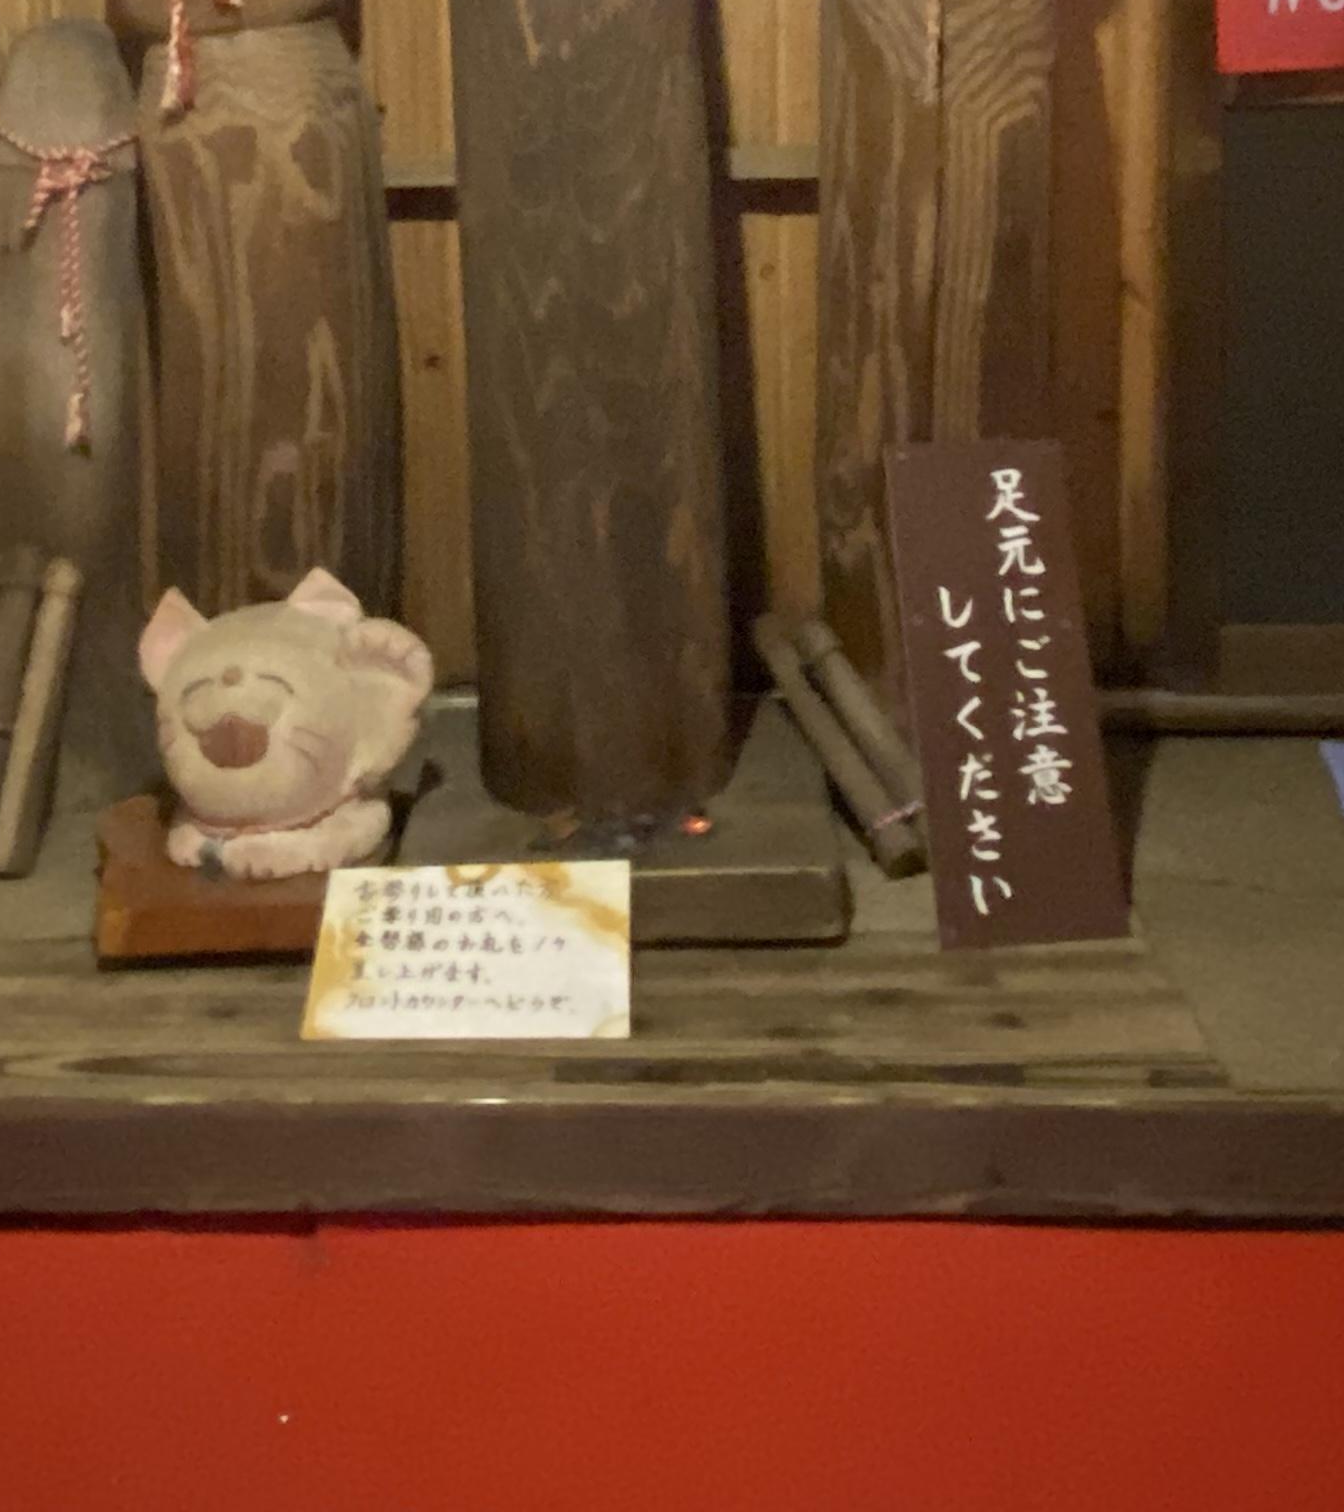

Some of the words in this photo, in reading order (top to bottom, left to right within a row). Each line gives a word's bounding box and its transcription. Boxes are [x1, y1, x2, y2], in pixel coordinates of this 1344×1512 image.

[936, 585, 1013, 918] してください
[986, 466, 1074, 807] 足元にご注意
